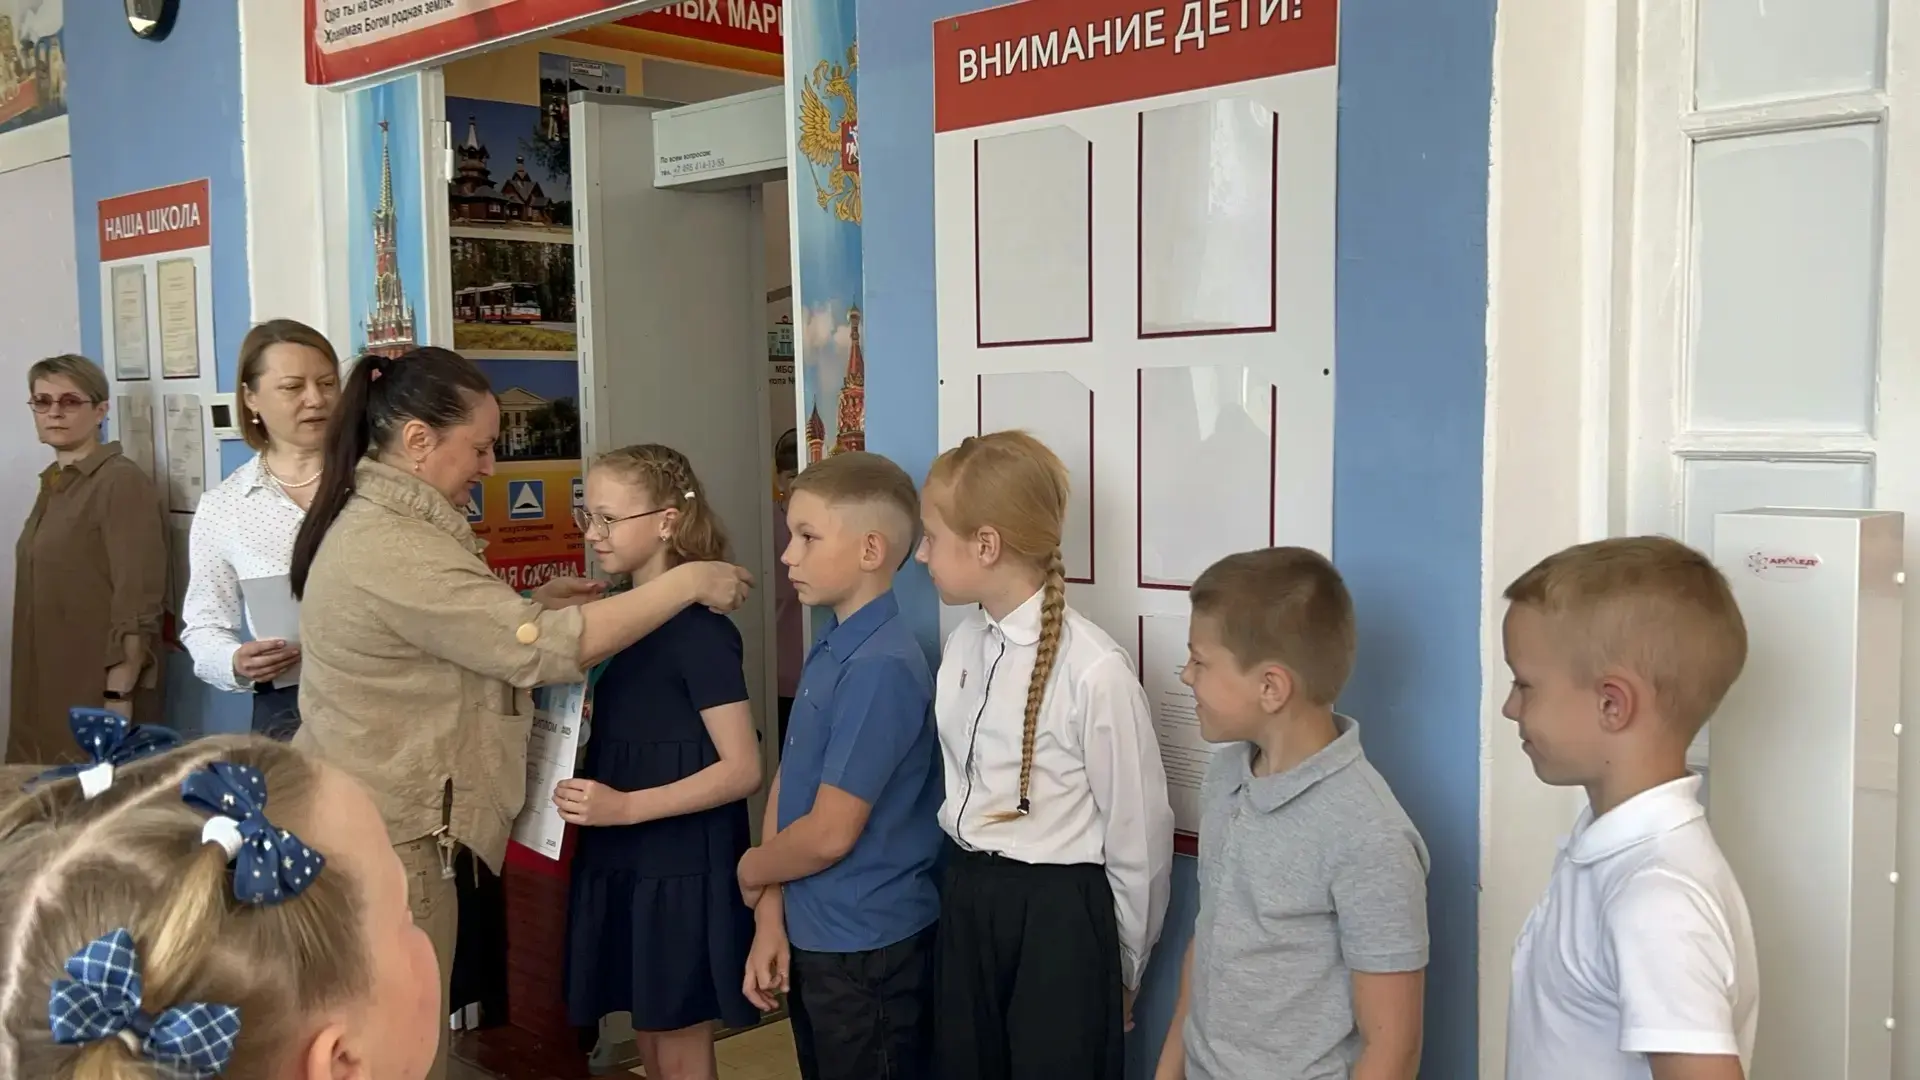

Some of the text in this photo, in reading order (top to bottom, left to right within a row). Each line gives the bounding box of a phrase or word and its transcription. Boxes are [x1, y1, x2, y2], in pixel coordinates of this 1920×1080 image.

[343, 3, 356, 16] ты
[358, 0, 368, 12] на
[364, 14, 390, 32] Богом
[391, 4, 424, 27] родная
[727, 0, 783, 37] МАР
[958, 0, 1303, 84] ВНИМАНИЕ ДЕТИ!
[104, 202, 200, 242] НАША ШКОЛА
[775, 365, 796, 374] МБО
